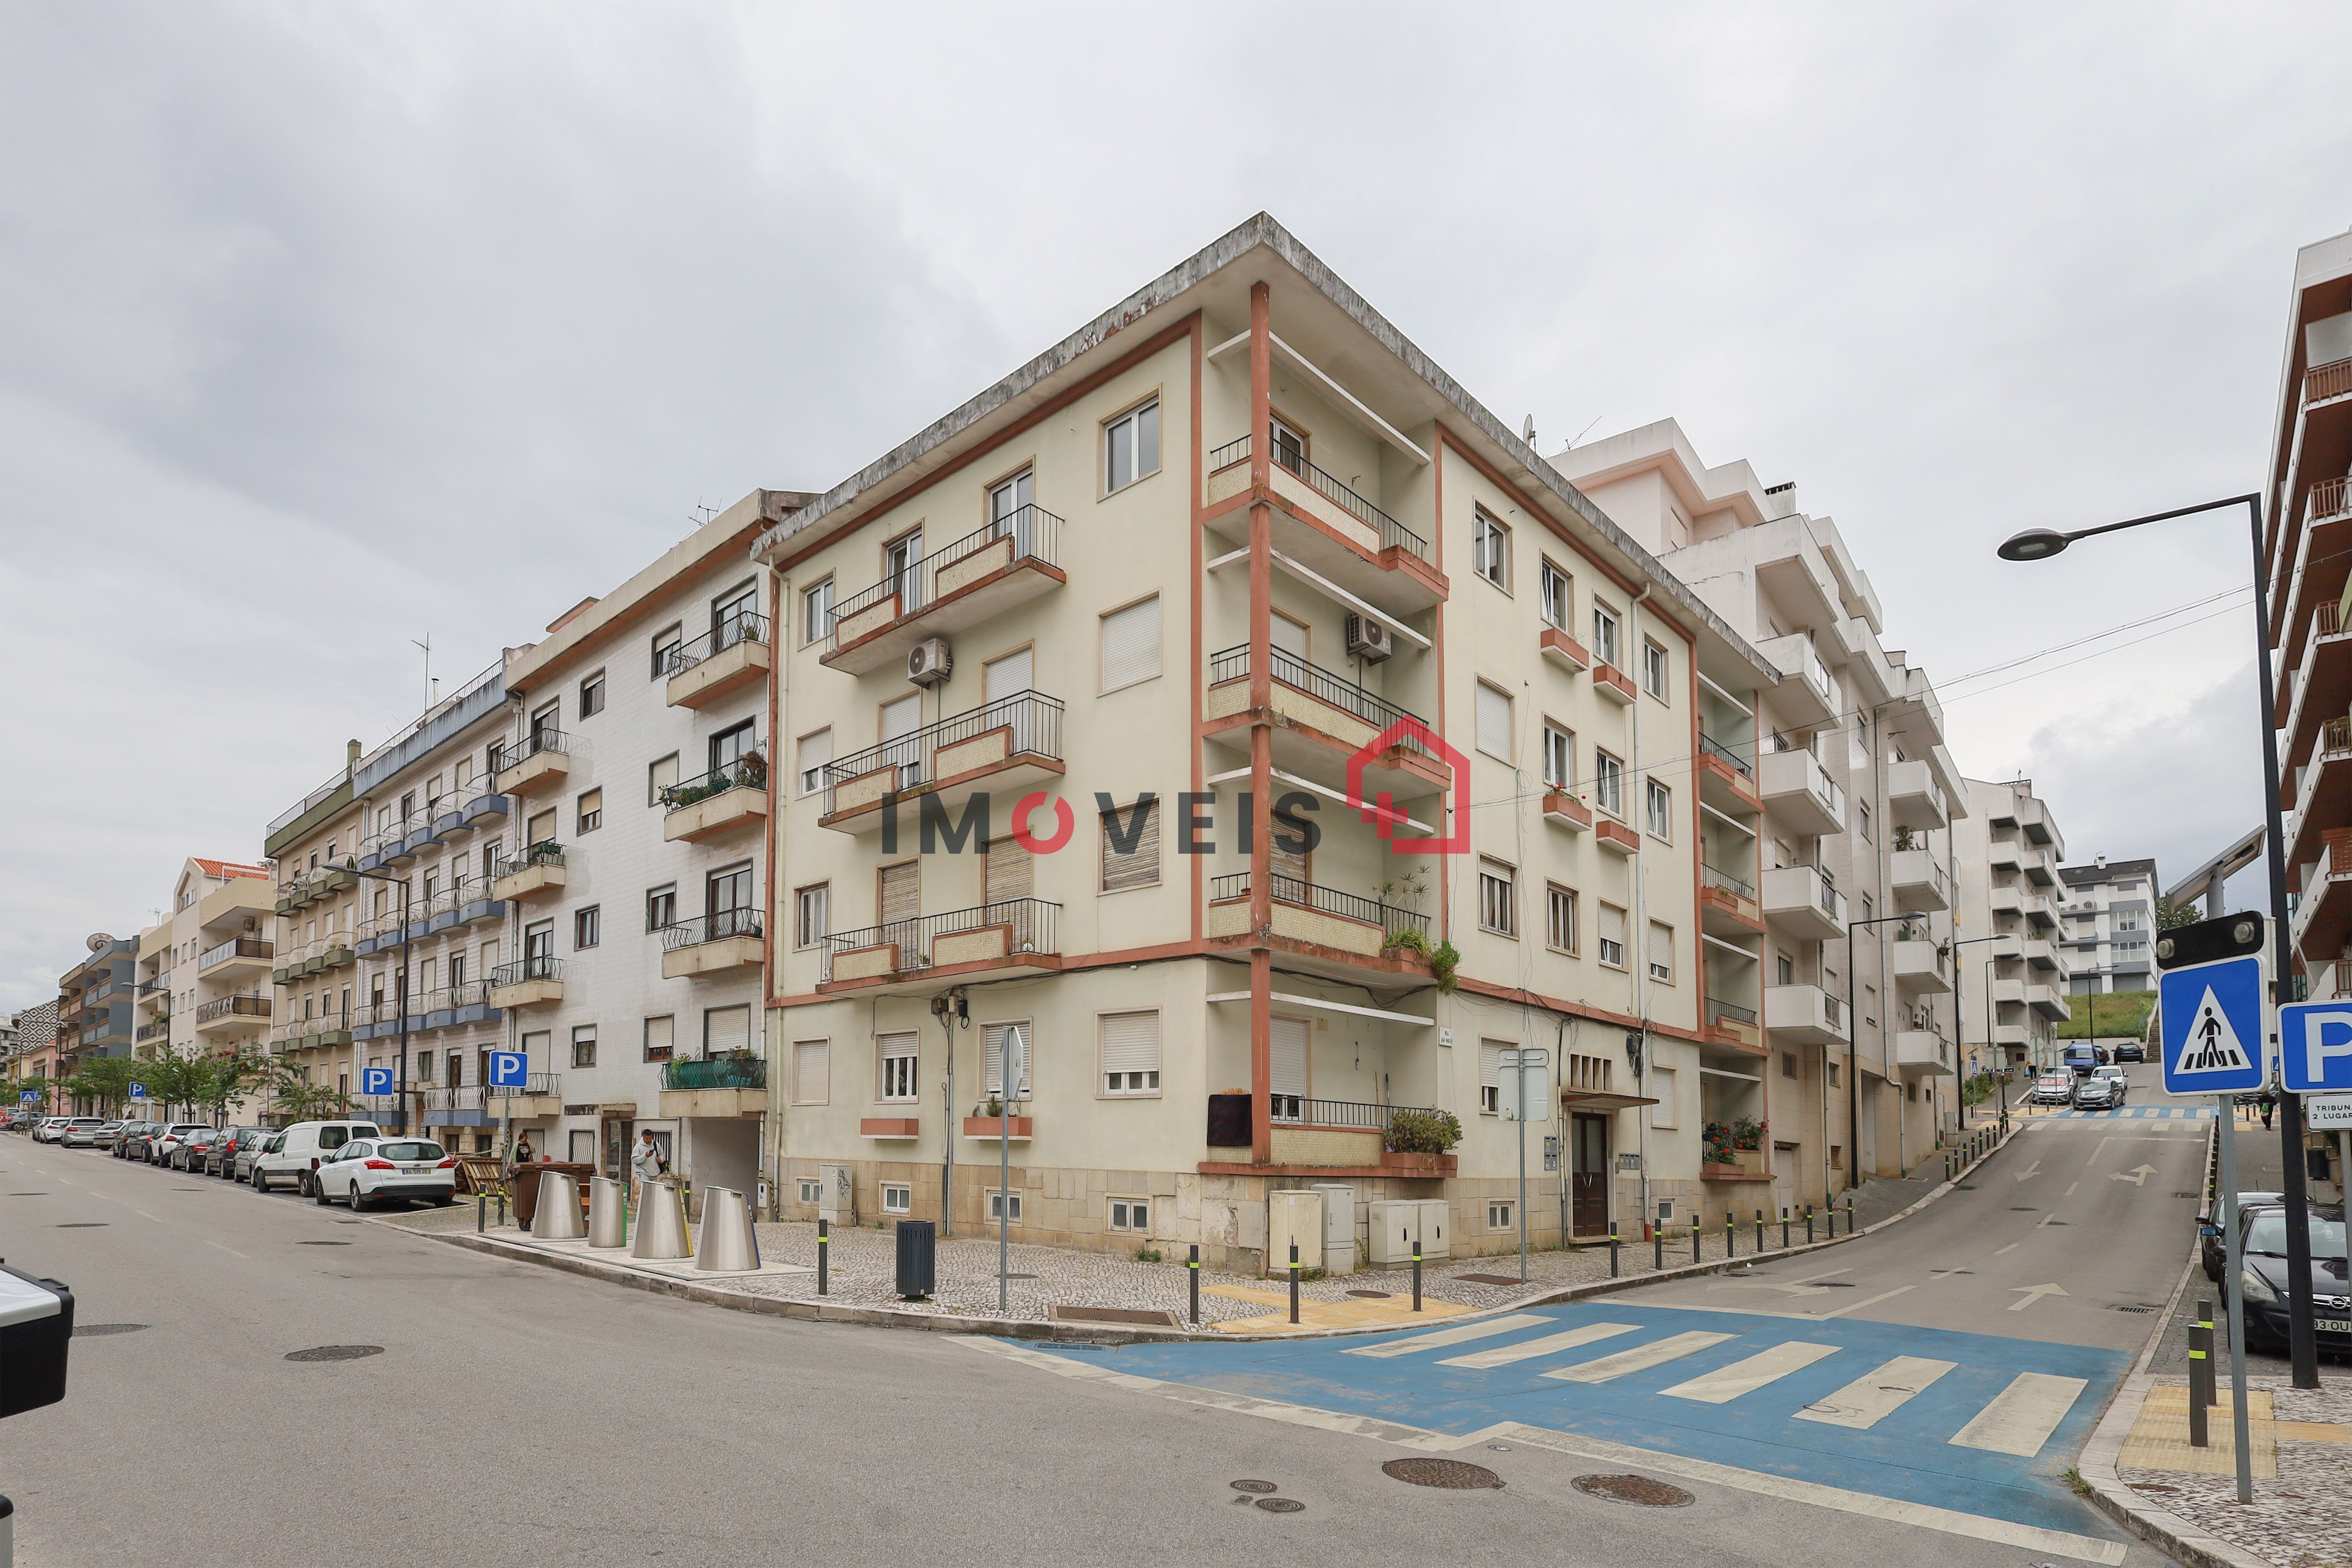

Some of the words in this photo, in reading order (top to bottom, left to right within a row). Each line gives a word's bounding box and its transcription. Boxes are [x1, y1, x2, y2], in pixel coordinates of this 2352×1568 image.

[2304, 1011, 2352, 1083] P
[369, 1070, 387, 1093] P
[498, 1055, 520, 1083] P
[133, 1084, 142, 1095] P
